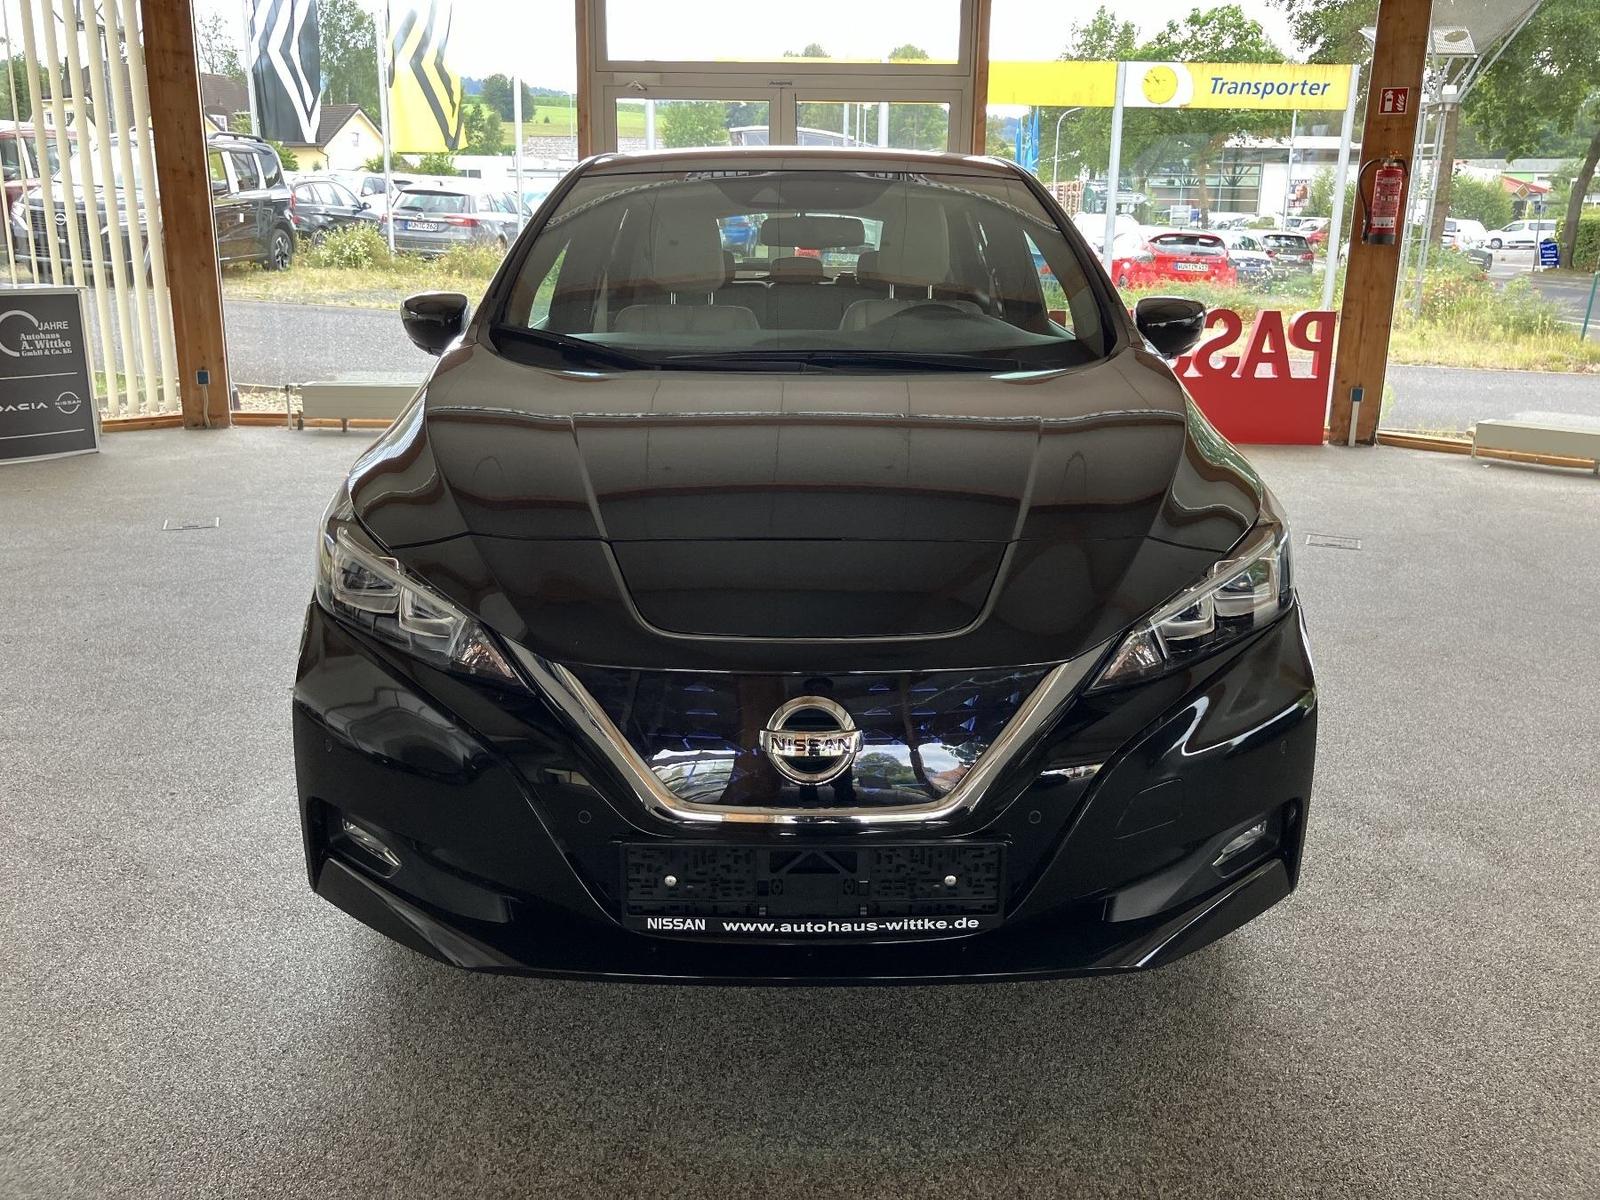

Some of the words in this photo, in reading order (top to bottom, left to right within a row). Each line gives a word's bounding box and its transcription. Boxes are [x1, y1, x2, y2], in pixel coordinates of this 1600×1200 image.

[1211, 77, 1331, 99] Transporter
[38, 320, 69, 331] JAHRE
[20, 332, 60, 341] Autohaus
[21, 340, 33, 350] A.
[35, 339, 72, 349] Wittke
[21, 349, 43, 357] GmbH
[771, 736, 852, 752] NISSAN
[647, 917, 706, 931] NISSAN
[722, 917, 980, 933] www.autohaus-wittke.de
